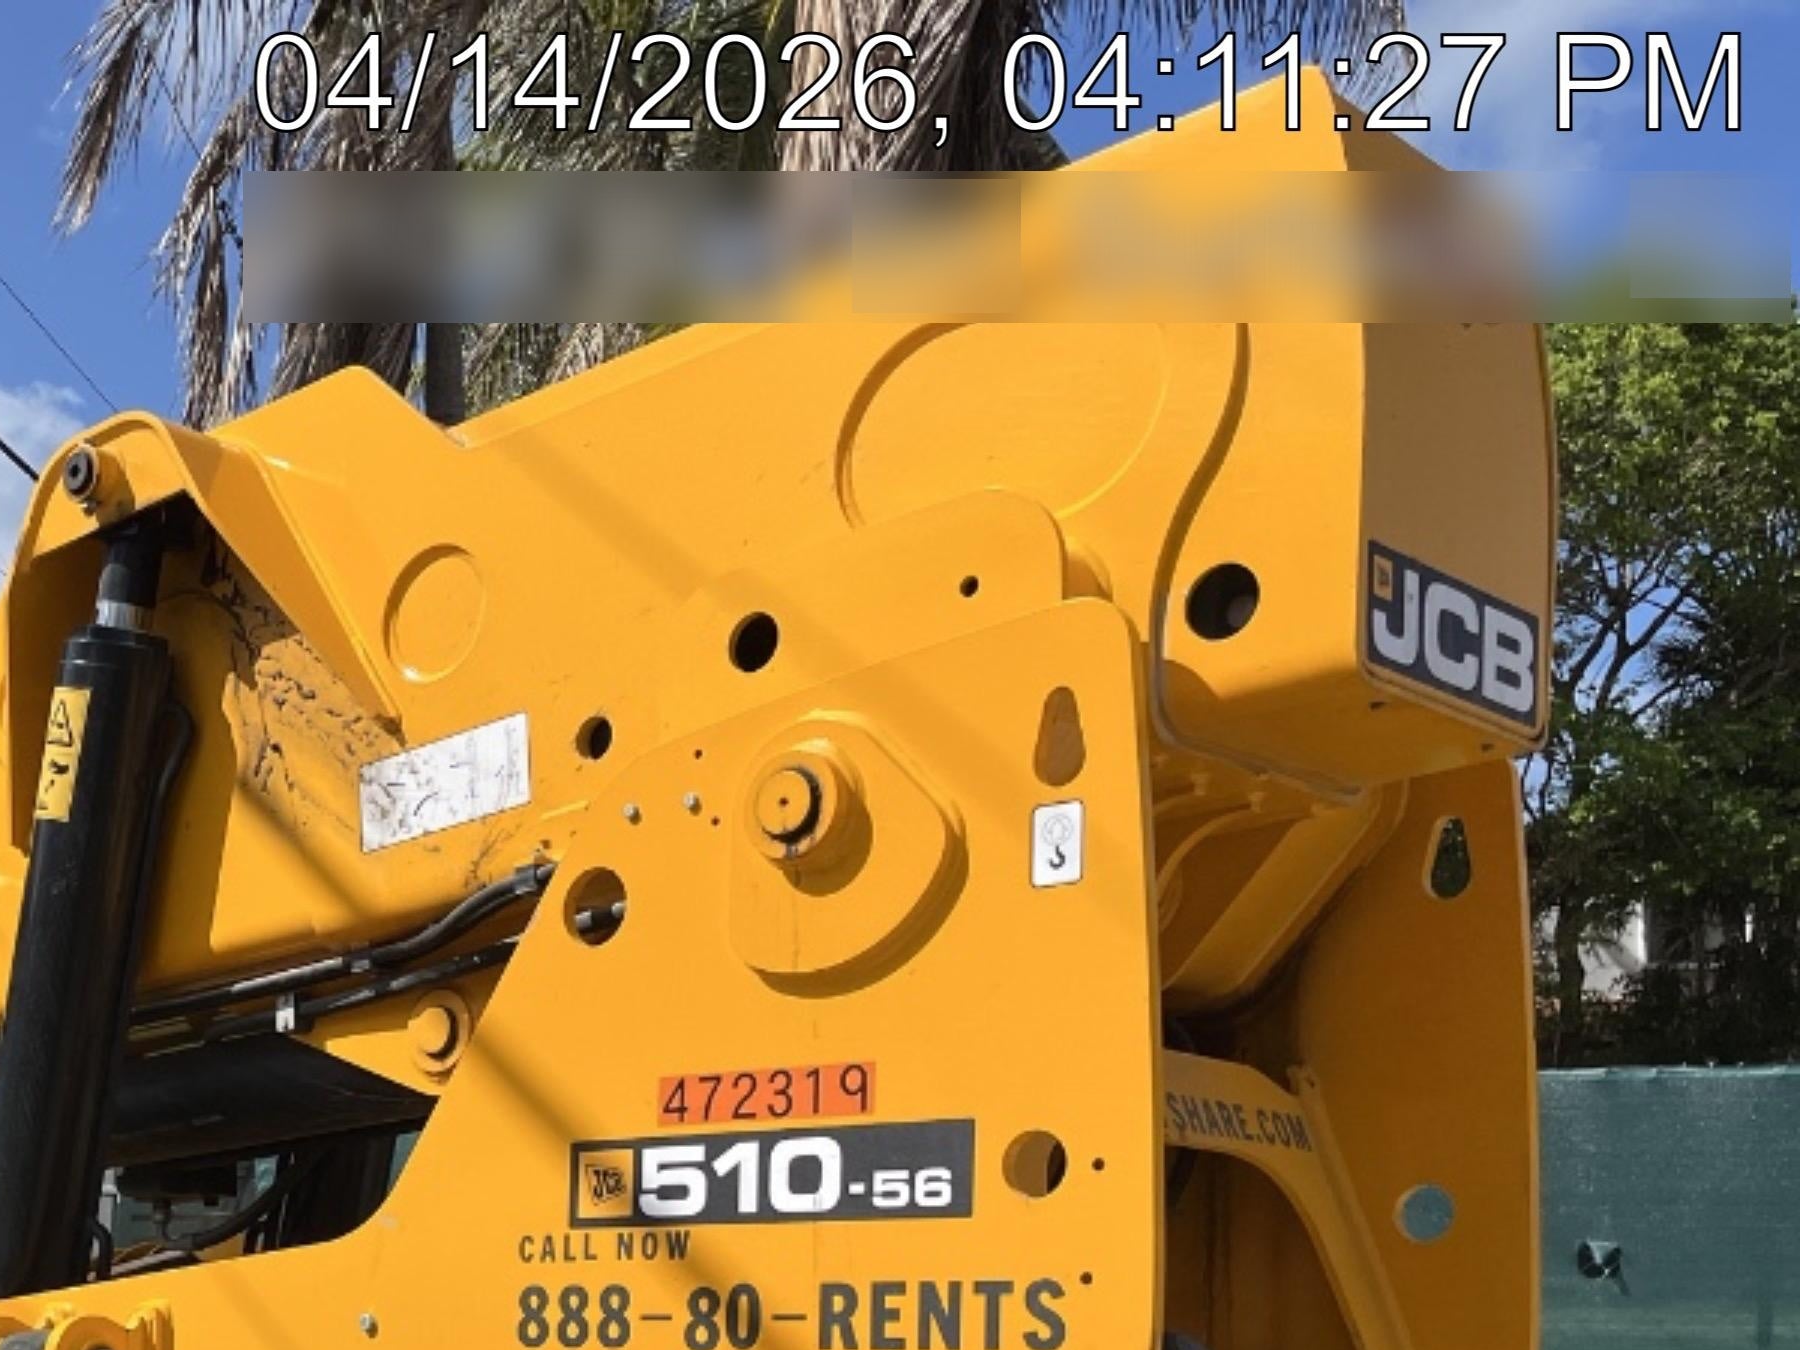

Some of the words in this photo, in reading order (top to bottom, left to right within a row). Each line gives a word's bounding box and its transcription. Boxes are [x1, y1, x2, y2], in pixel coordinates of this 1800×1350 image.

[1372, 568, 1535, 713] JCB
[662, 1064, 869, 1122] 472319
[1163, 1090, 1312, 1151] SHARE.COM
[638, 1135, 953, 1218] 510-56
[518, 1234, 597, 1263] CALL
[617, 1230, 690, 1260] NOW
